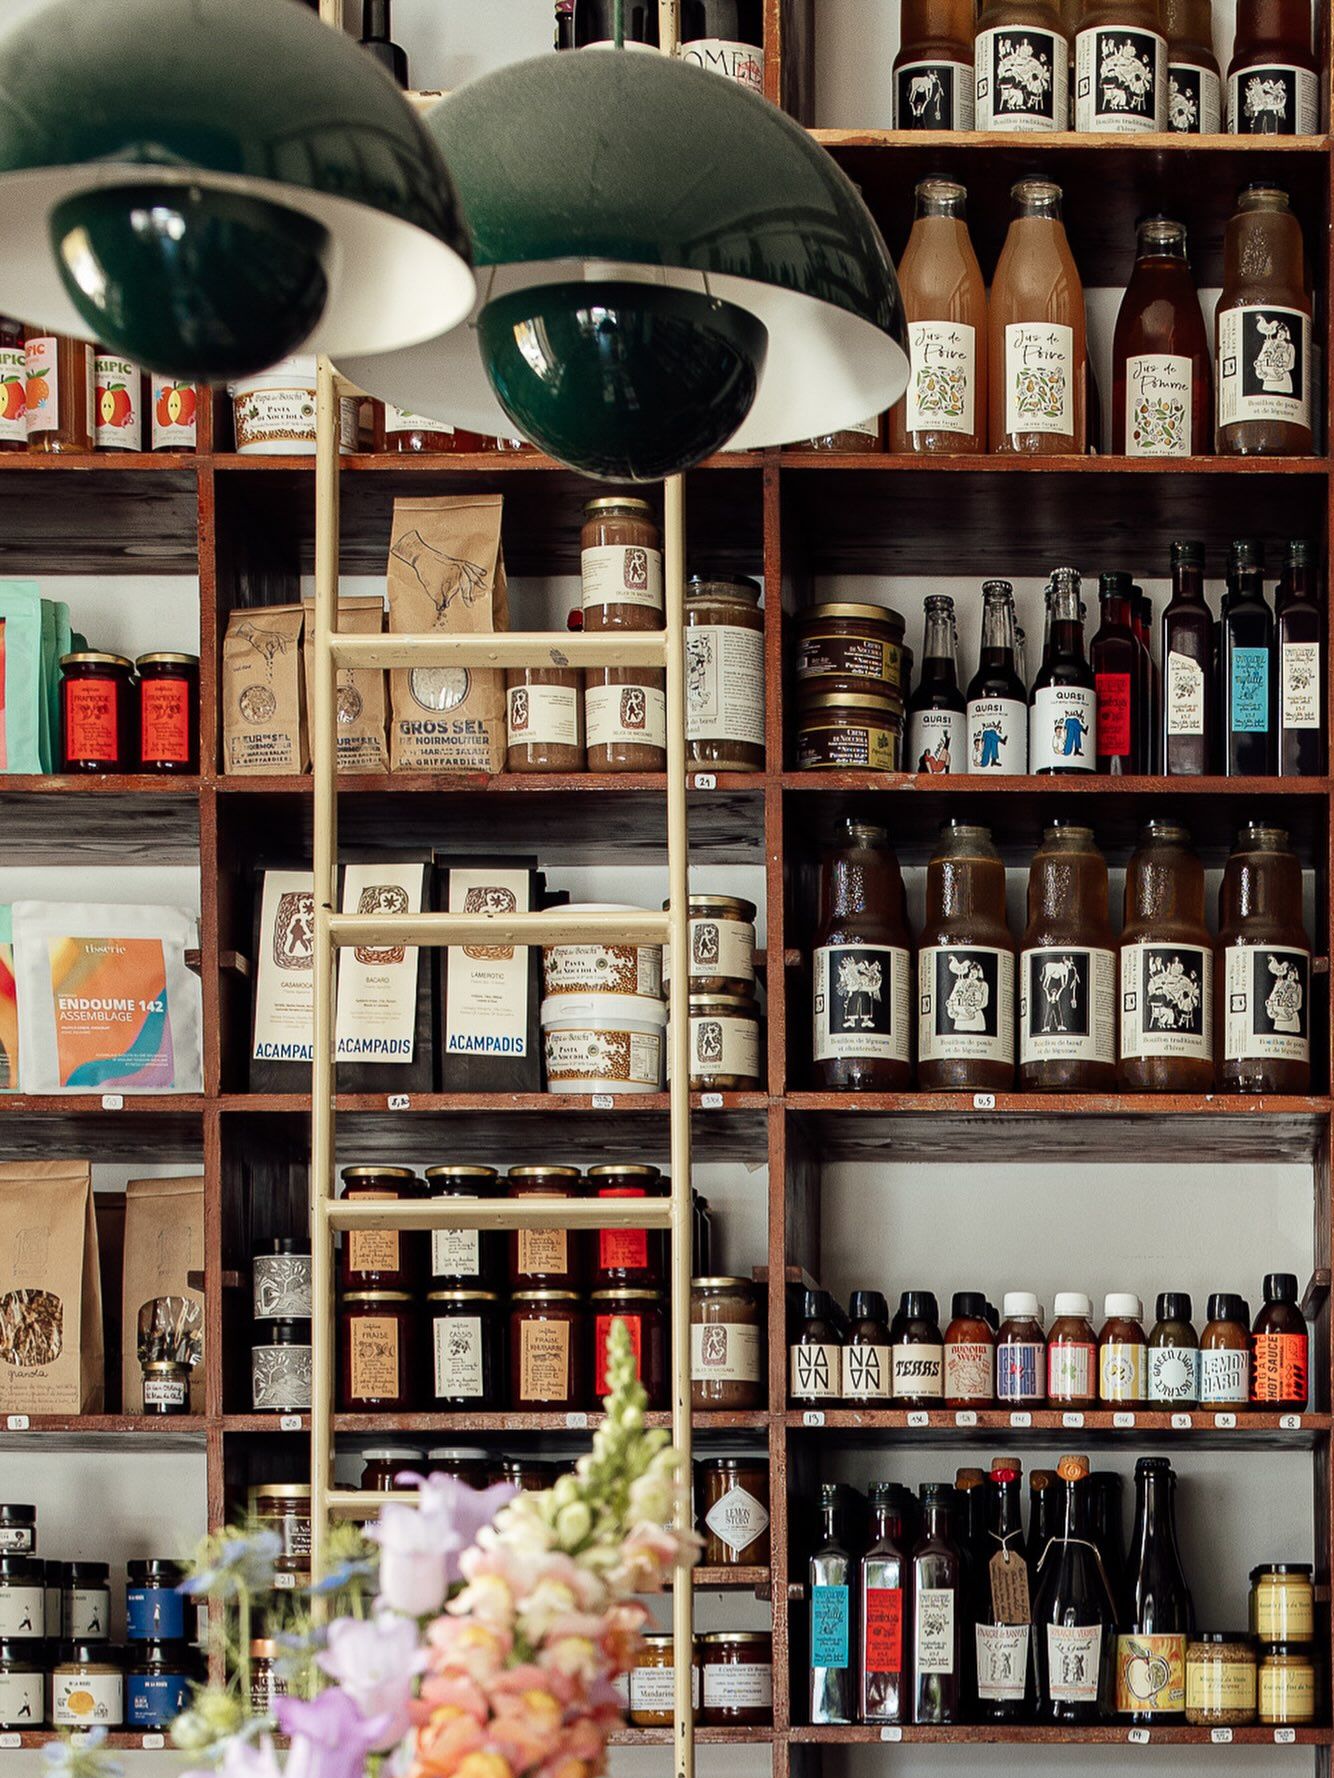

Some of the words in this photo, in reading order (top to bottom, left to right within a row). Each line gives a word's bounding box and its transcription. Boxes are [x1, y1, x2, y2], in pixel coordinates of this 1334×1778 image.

[915, 328, 941, 348] Jus
[947, 332, 961, 343] de
[1013, 329, 1039, 348] Jus
[1046, 333, 1060, 343] de
[923, 344, 967, 364] Poire
[1021, 344, 1066, 365] Poire
[1132, 360, 1159, 379] Jus
[1163, 364, 1177, 373] de
[1140, 376, 1189, 393] Pomme
[1056, 691, 1086, 701] QUASI
[975, 704, 1003, 712] QUASI
[400, 719, 450, 735] GROS
[452, 720, 490, 735] SEL
[923, 715, 952, 724] QUASI
[416, 736, 490, 746] NOIRMOUTIER
[700, 777, 710, 787] 21
[59, 998, 135, 1012] ENDOUME
[138, 1000, 164, 1013] 142
[59, 1012, 132, 1022] ASSEMBLAGE
[256, 1042, 314, 1059] ACAMPAD
[338, 1038, 411, 1055] ACAMPADIS
[449, 1034, 524, 1054] ACAMPADIS
[1268, 1336, 1279, 1378] SAUCE
[8, 1369, 48, 1380] granola
[1258, 1335, 1267, 1400] ORGANIC
[1267, 1380, 1279, 1399] HOT
